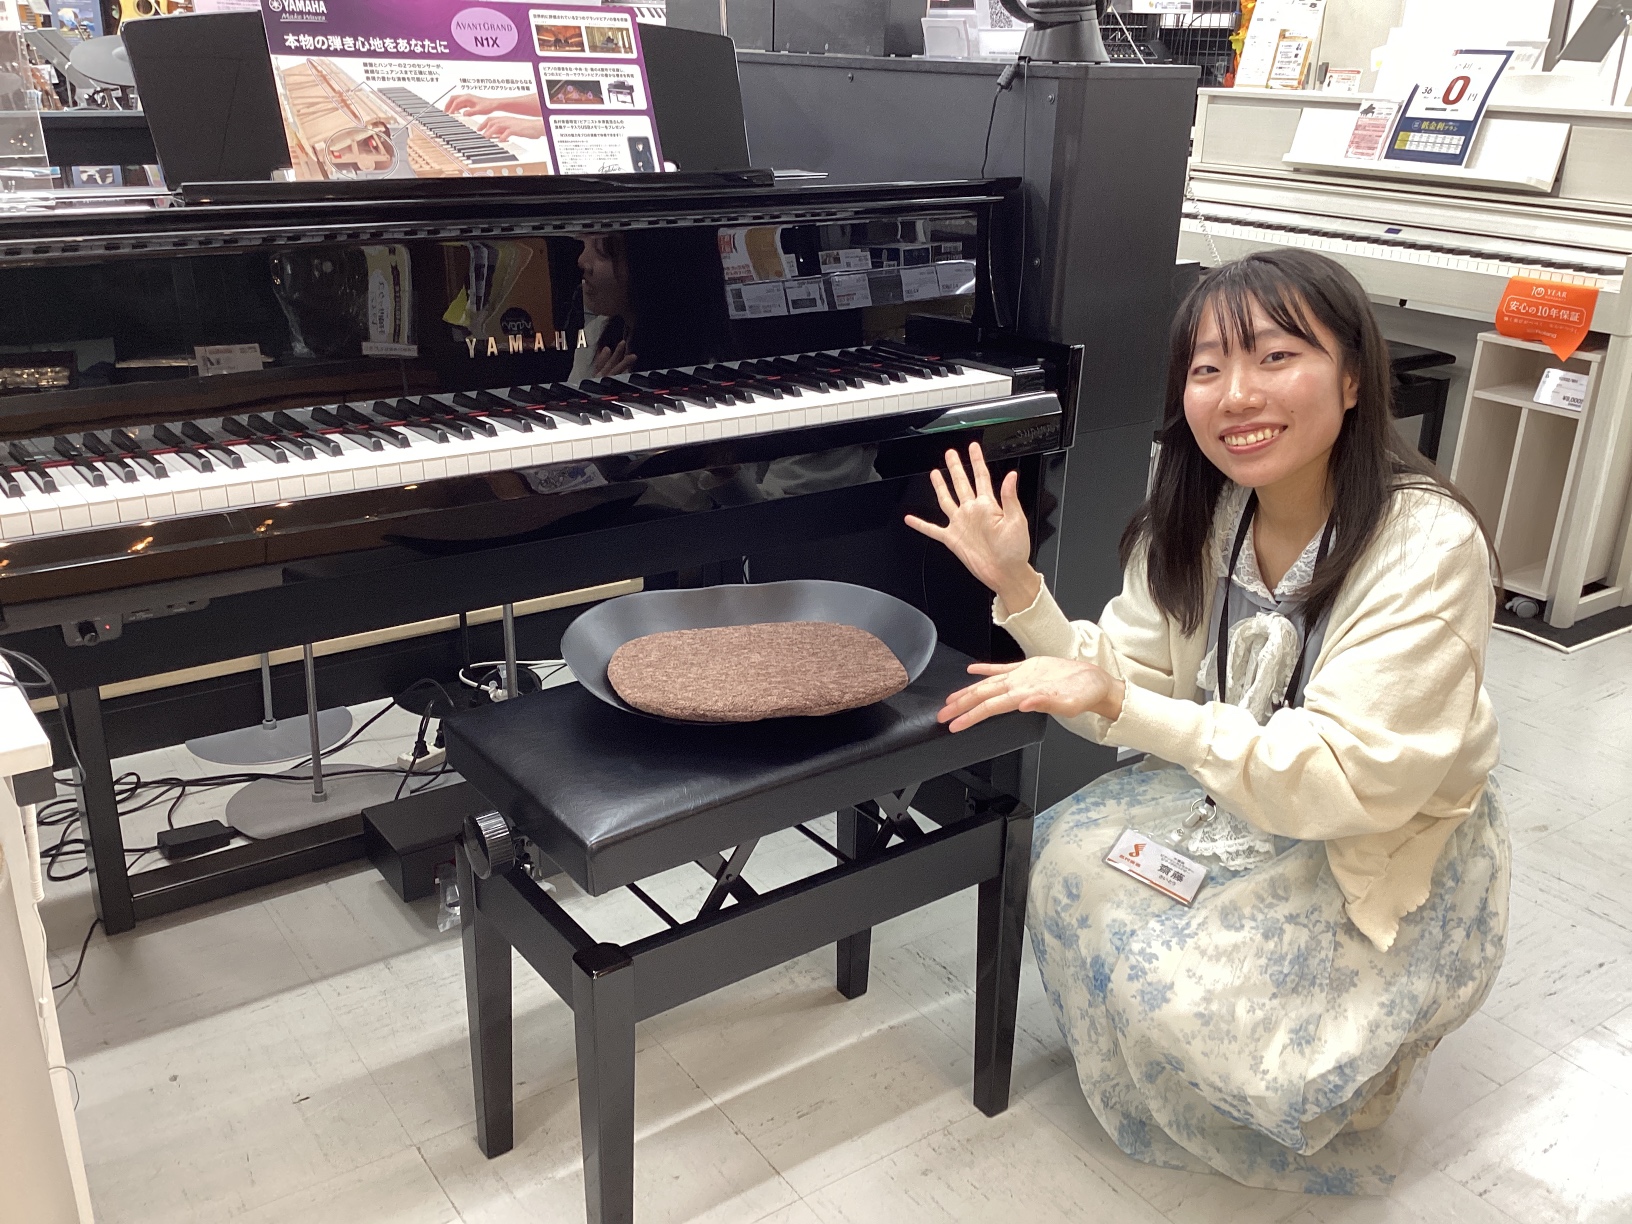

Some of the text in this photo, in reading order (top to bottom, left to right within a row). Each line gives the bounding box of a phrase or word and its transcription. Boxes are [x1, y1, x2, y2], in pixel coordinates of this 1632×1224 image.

[282, 0, 327, 13] YAMAHA
[283, 32, 450, 54] 本物の弾き心地をあなたに
[474, 36, 501, 48] N1X
[1441, 75, 1471, 105] 0
[1531, 286, 1545, 298] 10
[1547, 288, 1568, 299] YEAR
[1508, 300, 1581, 323] 安心の10年保証
[465, 328, 588, 359] YAMAHA
